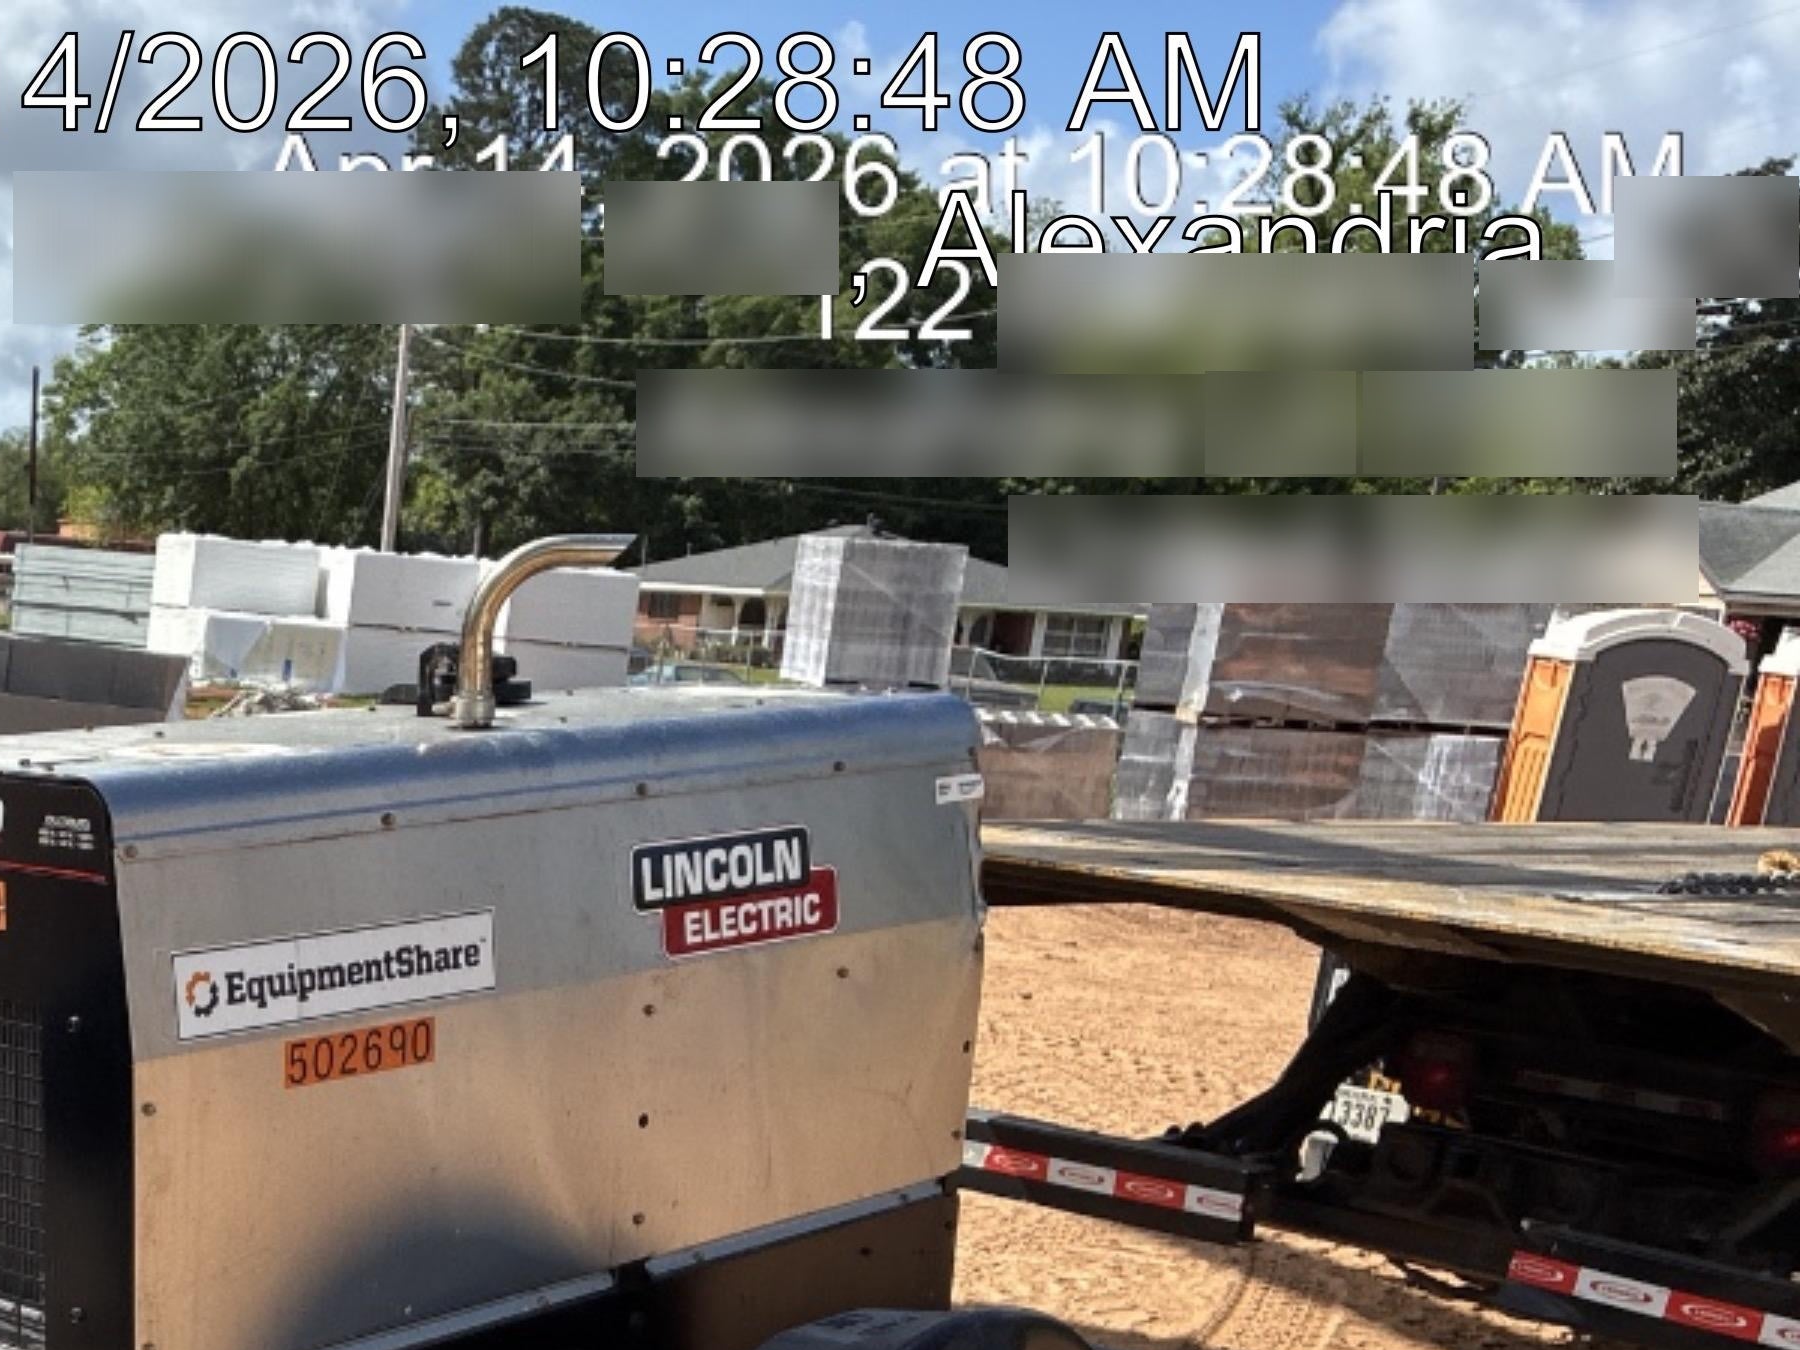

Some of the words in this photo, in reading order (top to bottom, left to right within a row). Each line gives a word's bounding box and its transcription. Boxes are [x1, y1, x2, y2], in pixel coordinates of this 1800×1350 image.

[641, 836, 802, 901] LINCOLN
[683, 893, 822, 945] ELECTRIC
[224, 943, 481, 1008] EquipmentShare
[288, 1021, 432, 1085] 502690
